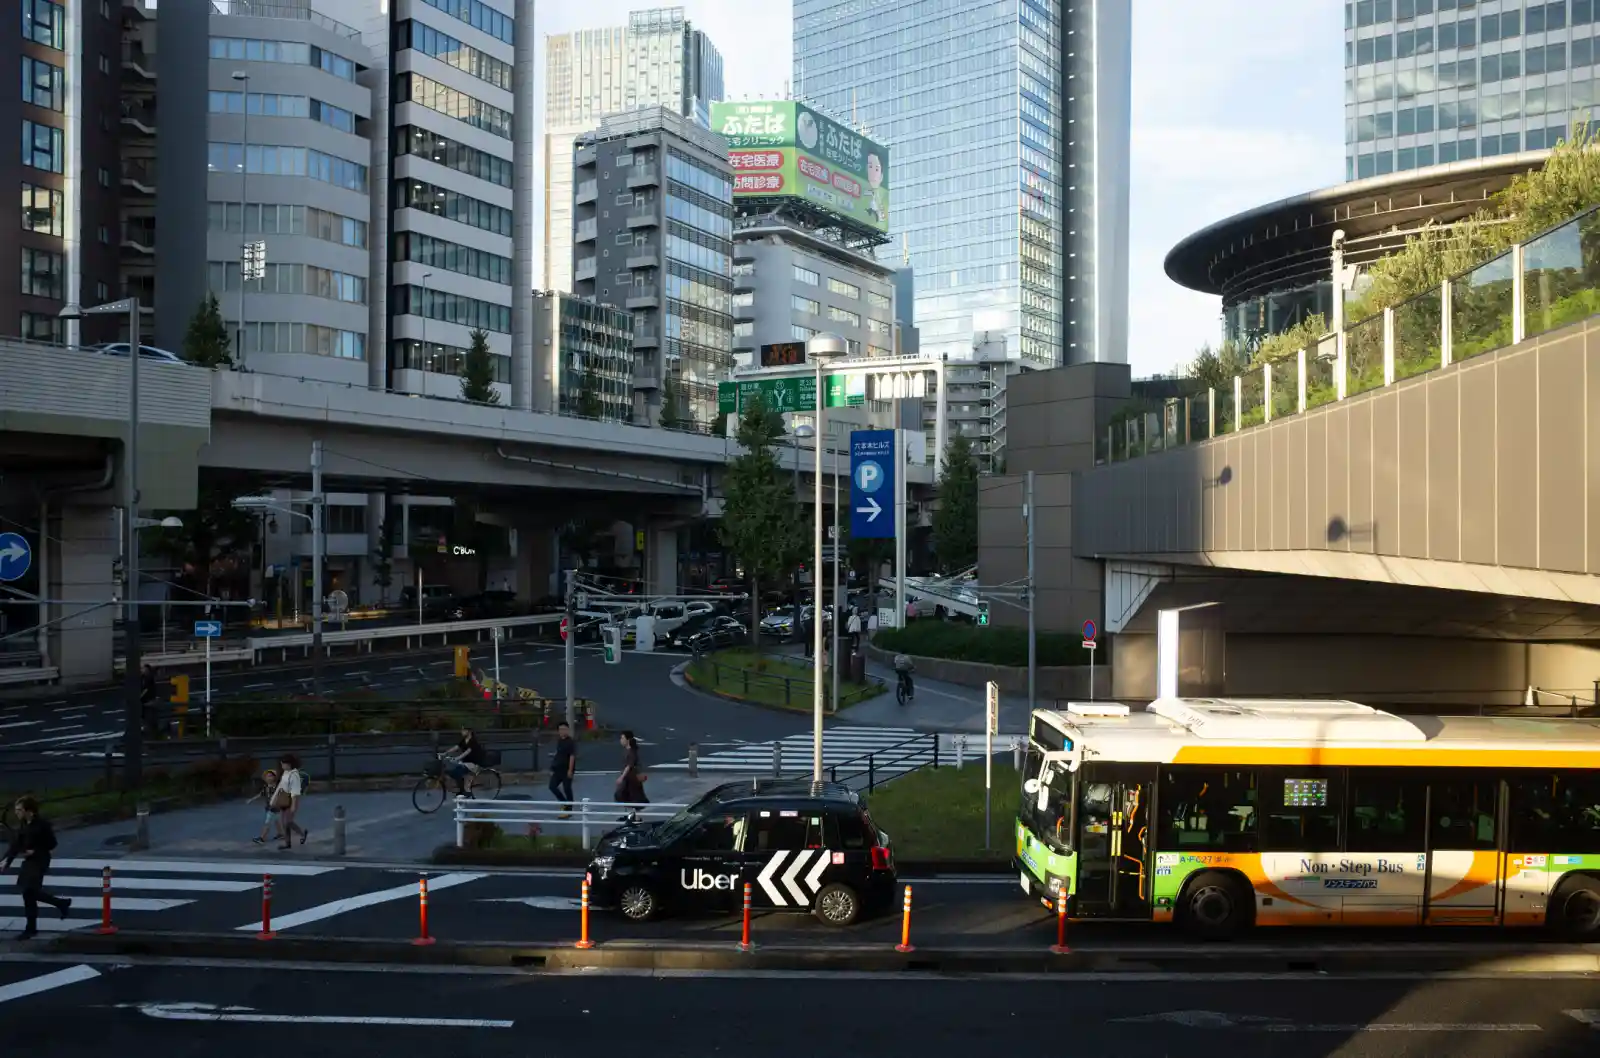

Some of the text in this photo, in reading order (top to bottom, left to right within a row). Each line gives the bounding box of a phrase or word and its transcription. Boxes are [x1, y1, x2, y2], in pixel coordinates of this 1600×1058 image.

[722, 113, 786, 134] ふたば
[826, 124, 862, 158] ふたば
[729, 154, 779, 167] 在宅医療
[854, 441, 890, 450] 六本木ヒルズ
[861, 465, 877, 489] P
[1340, 859, 1372, 876] Step
[1377, 859, 1403, 873] Bus
[680, 868, 739, 890] Uber
[1325, 880, 1377, 888] ノンステップバス
